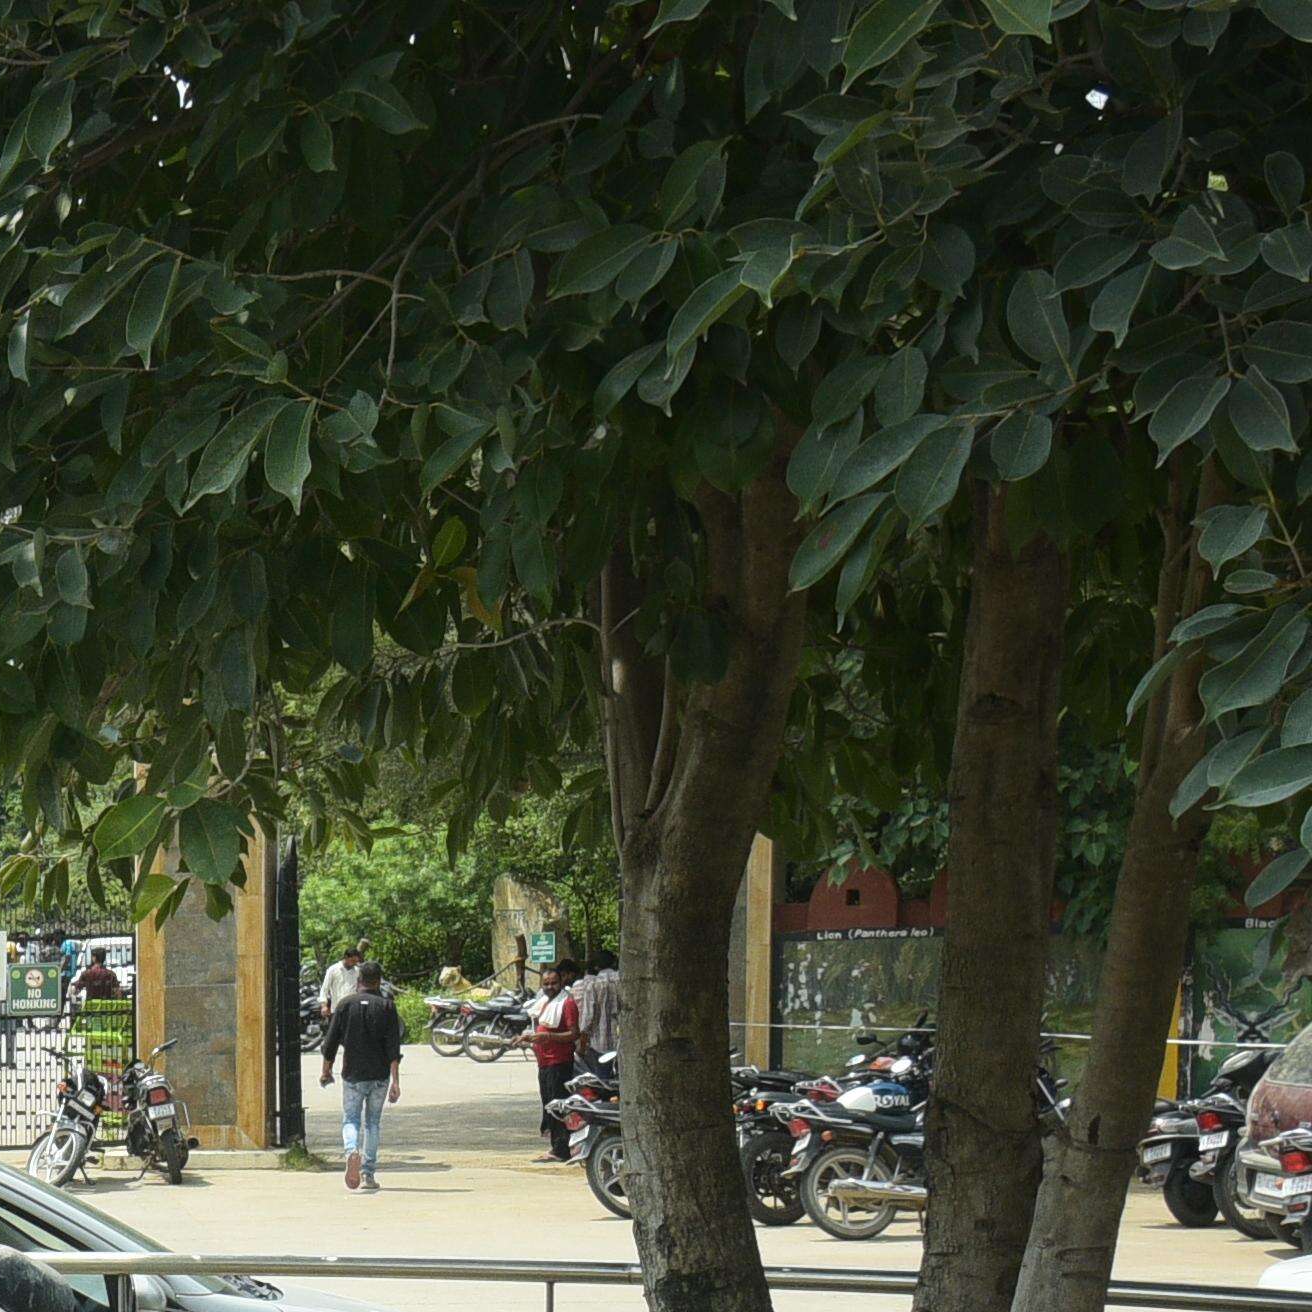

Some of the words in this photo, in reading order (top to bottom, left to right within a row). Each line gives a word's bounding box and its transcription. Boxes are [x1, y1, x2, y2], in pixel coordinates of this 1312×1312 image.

[816, 930, 842, 940] Lion
[27, 989, 41, 998] NO
[12, 999, 57, 1009] HONKING
[874, 1094, 910, 1108] ROYAL
